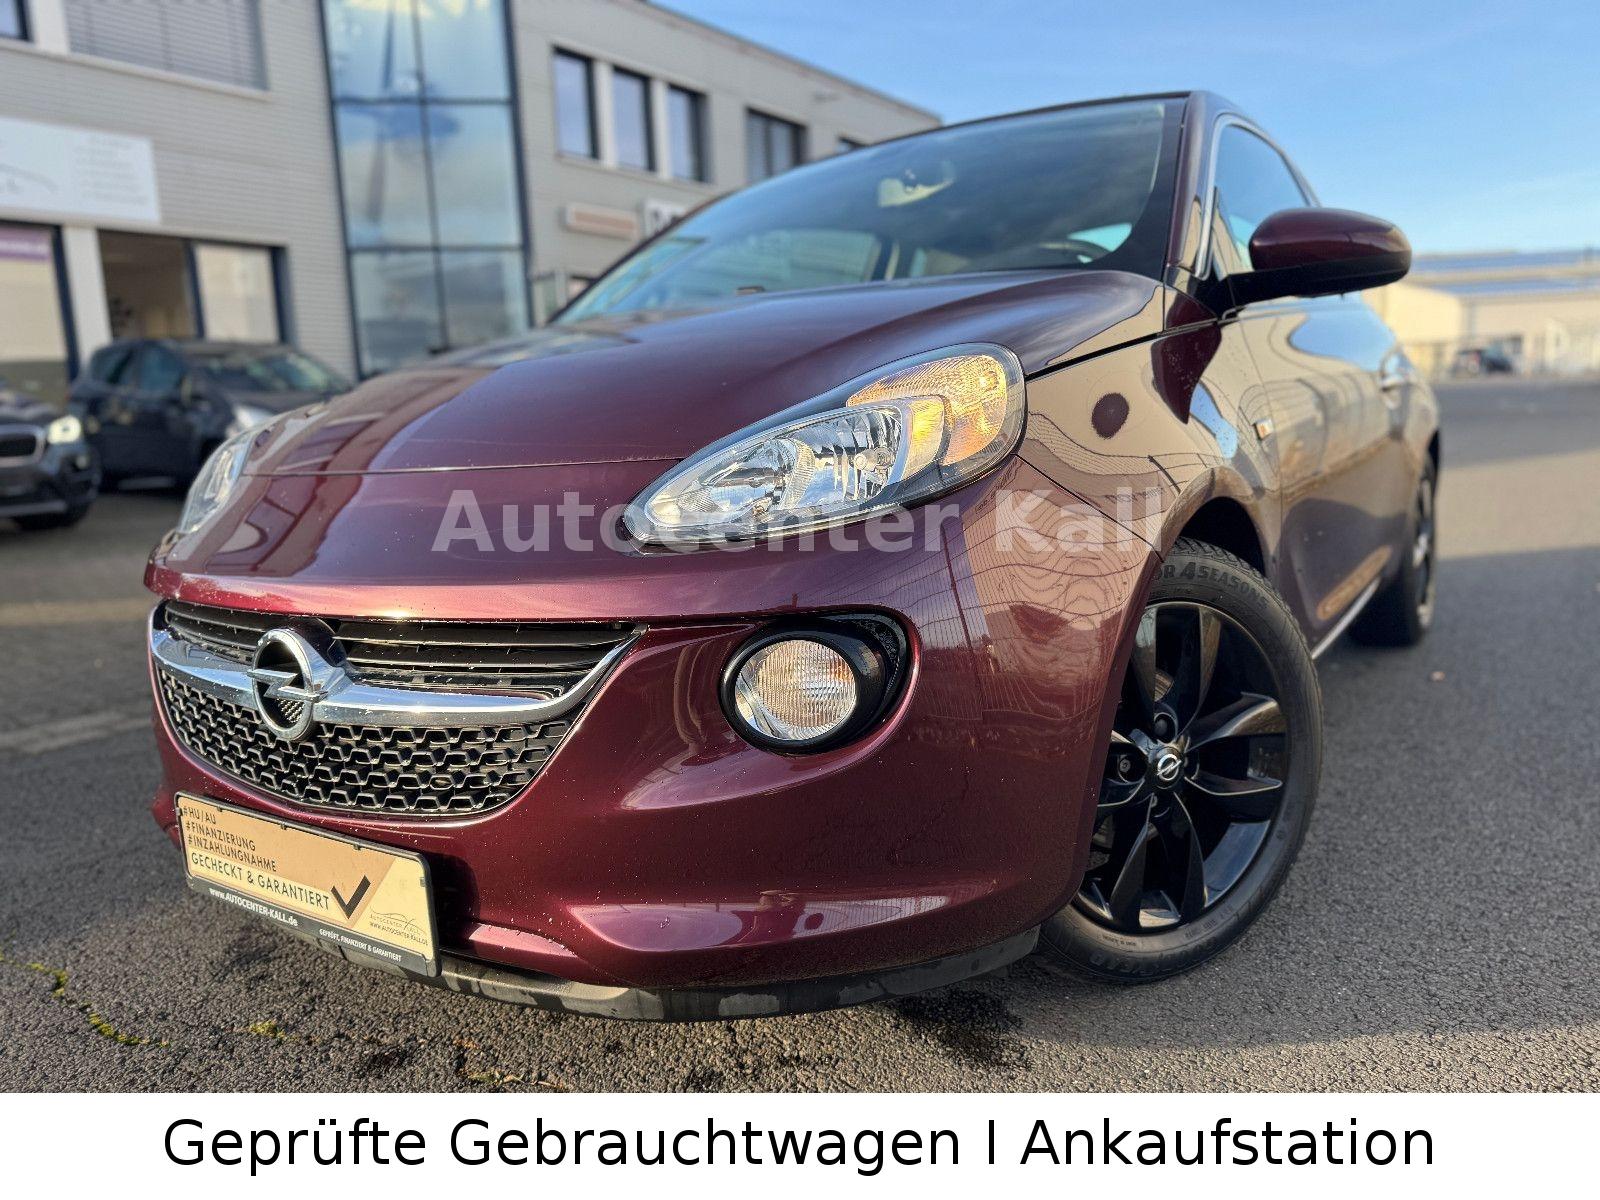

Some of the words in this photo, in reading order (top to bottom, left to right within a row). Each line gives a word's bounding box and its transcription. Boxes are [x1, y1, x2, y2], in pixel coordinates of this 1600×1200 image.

[186, 821, 256, 851] #FINANZIERUNG
[188, 834, 277, 872] #INZAHLUNGNAHME
[191, 852, 242, 881] GECHECKT
[247, 870, 255, 885] &
[257, 874, 329, 910] GARANTIERT
[208, 887, 299, 927] www.AUTOCENTER-KALL.de
